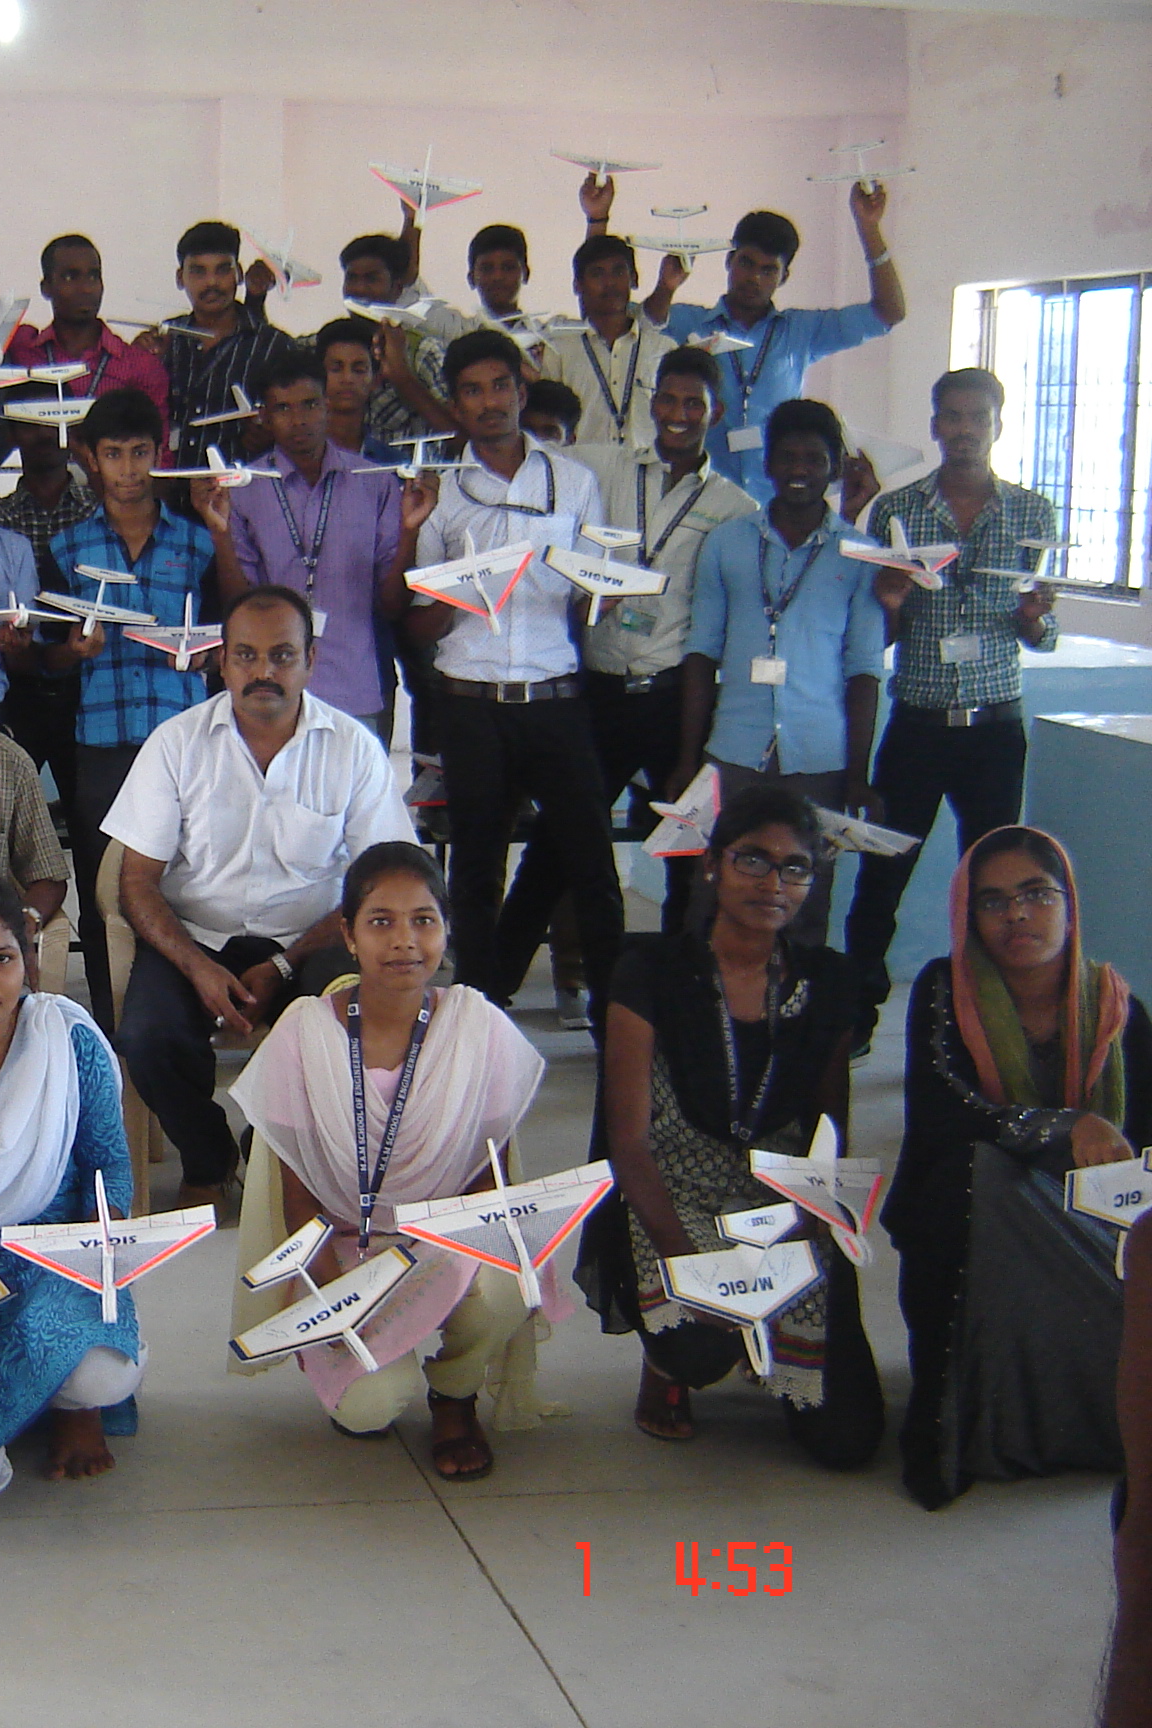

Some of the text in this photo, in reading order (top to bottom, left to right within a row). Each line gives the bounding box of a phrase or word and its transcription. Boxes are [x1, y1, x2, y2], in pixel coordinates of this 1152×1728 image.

[579, 569, 623, 586] MAGIC
[350, 1037, 367, 1172] M.A.M SCHOOL OF ENGINEERING
[378, 1042, 420, 1172] M.A.M SCHOOL OF ENGINEERING
[478, 1203, 538, 1225] SIGMA
[295, 1291, 362, 1334] MAGIC
